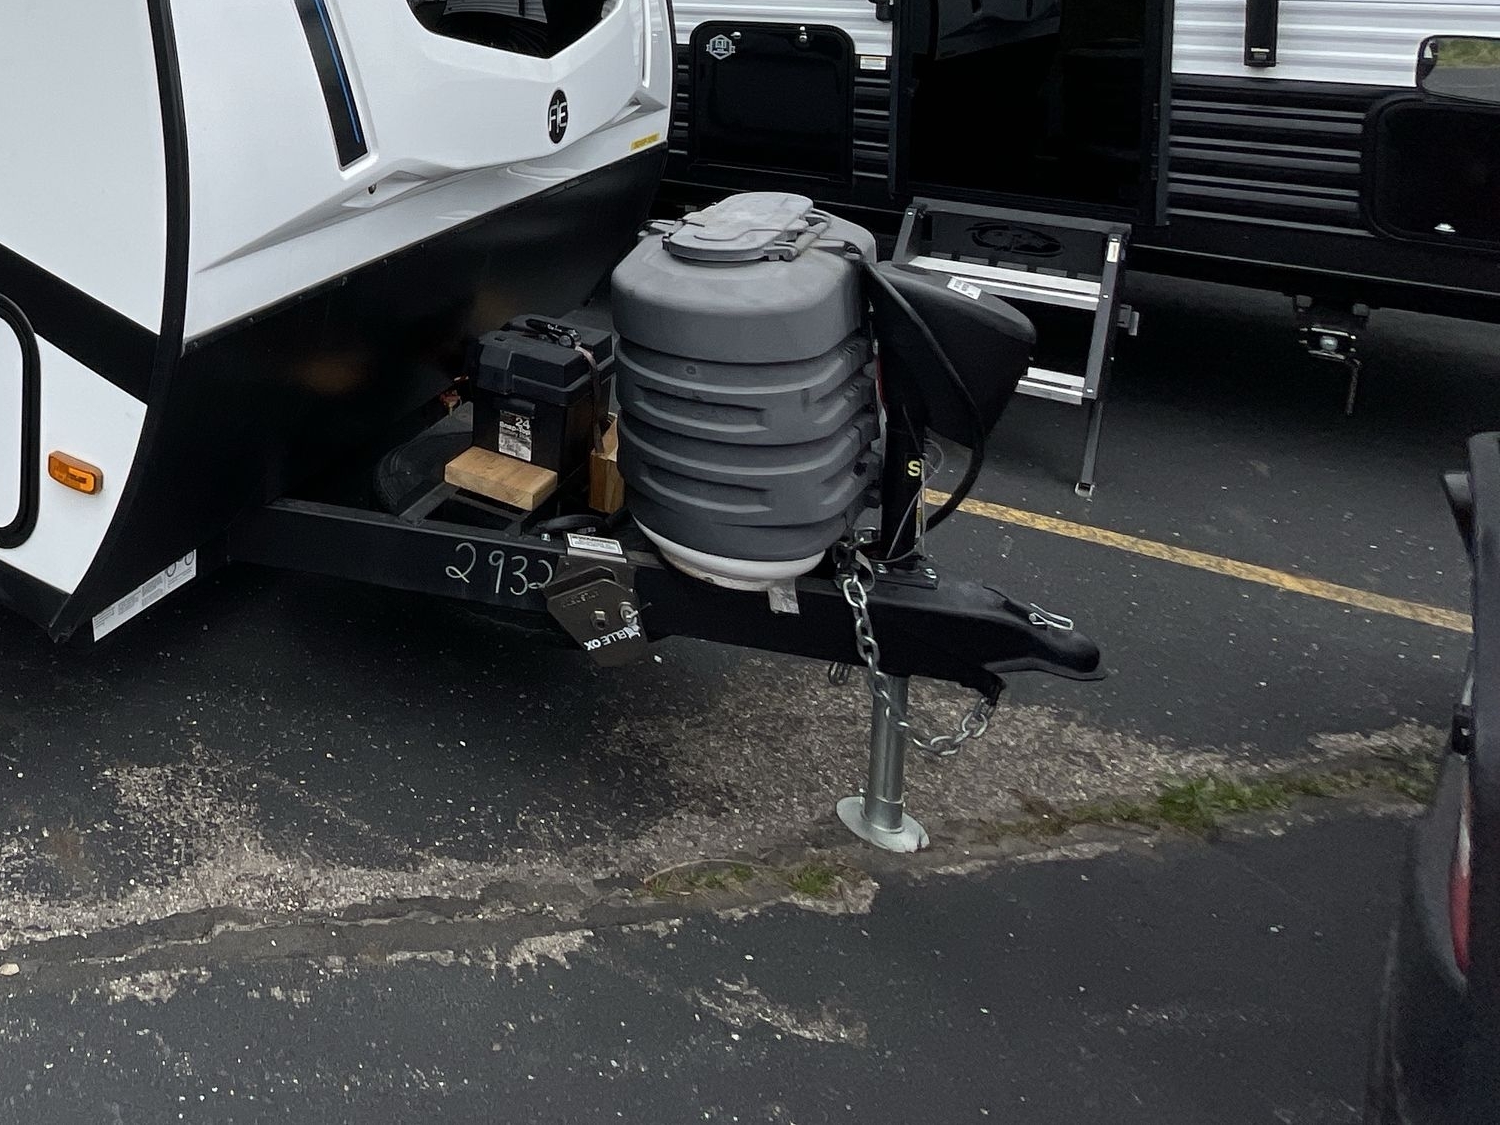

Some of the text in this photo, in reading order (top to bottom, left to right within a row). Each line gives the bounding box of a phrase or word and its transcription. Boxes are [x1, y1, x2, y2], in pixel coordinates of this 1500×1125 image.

[515, 417, 531, 430] 24
[907, 459, 921, 477] S
[445, 542, 554, 596] 2932
[583, 628, 628, 651] BLUE OX
